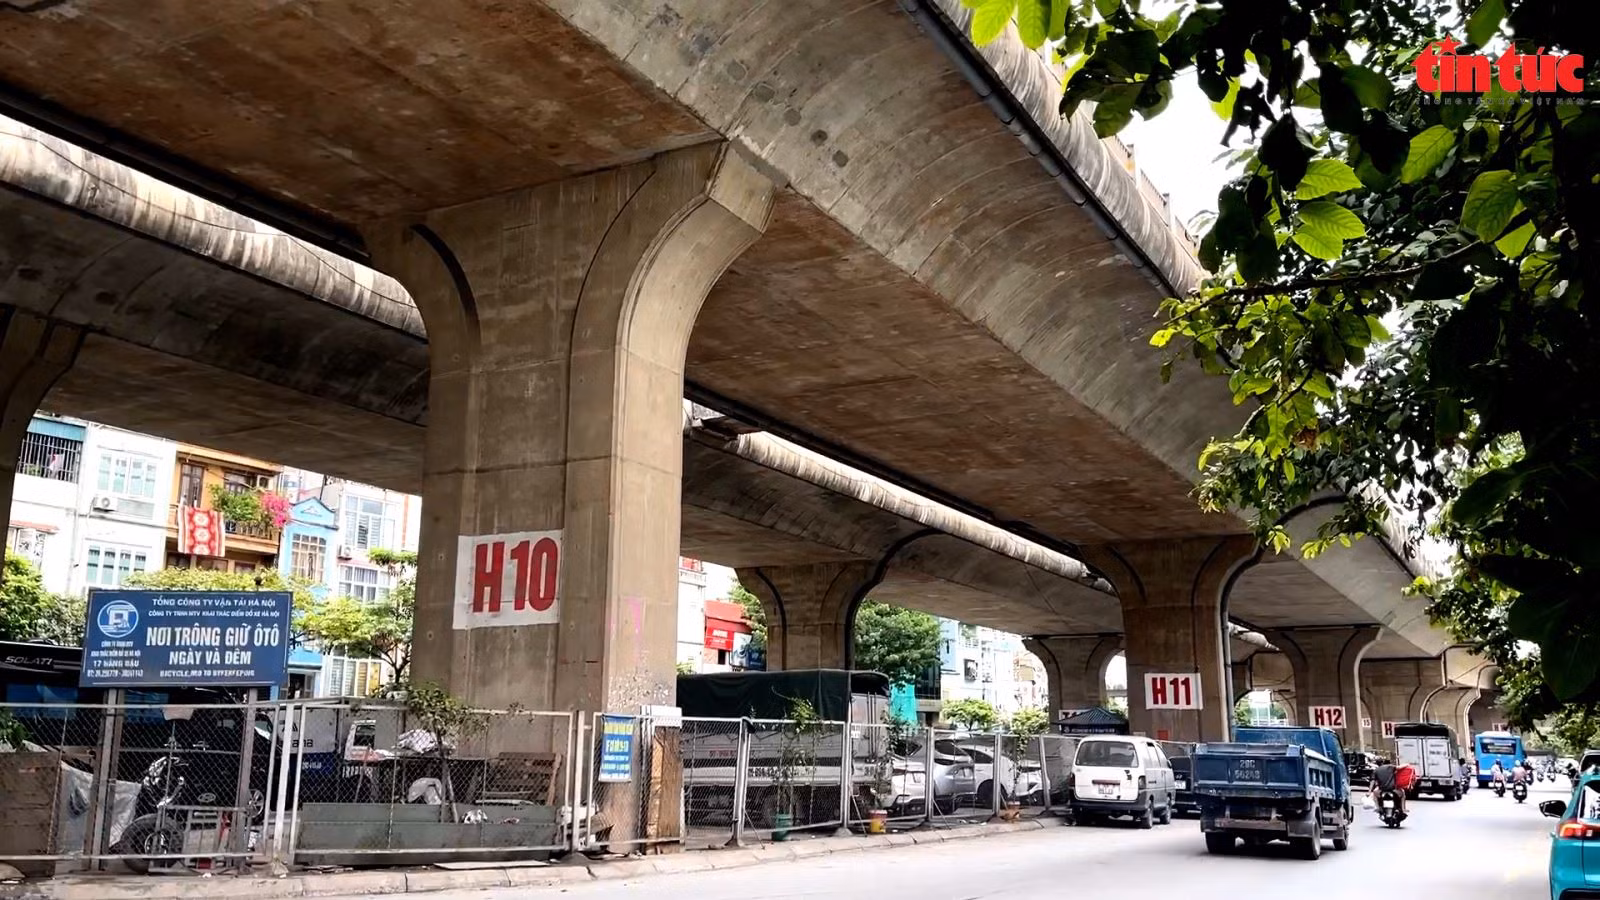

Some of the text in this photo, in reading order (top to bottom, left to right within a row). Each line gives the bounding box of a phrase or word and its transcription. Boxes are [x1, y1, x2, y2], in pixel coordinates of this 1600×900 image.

[472, 537, 558, 613] H10
[174, 622, 221, 646] TRÔNG
[225, 623, 252, 646] GIỮ
[253, 623, 280, 646] ÔTÔ
[5, 656, 53, 665] SOLATI
[168, 648, 252, 665] NGÀY VÀ ĐÊM
[1151, 677, 1191, 705] H11
[1314, 708, 1342, 726] H12
